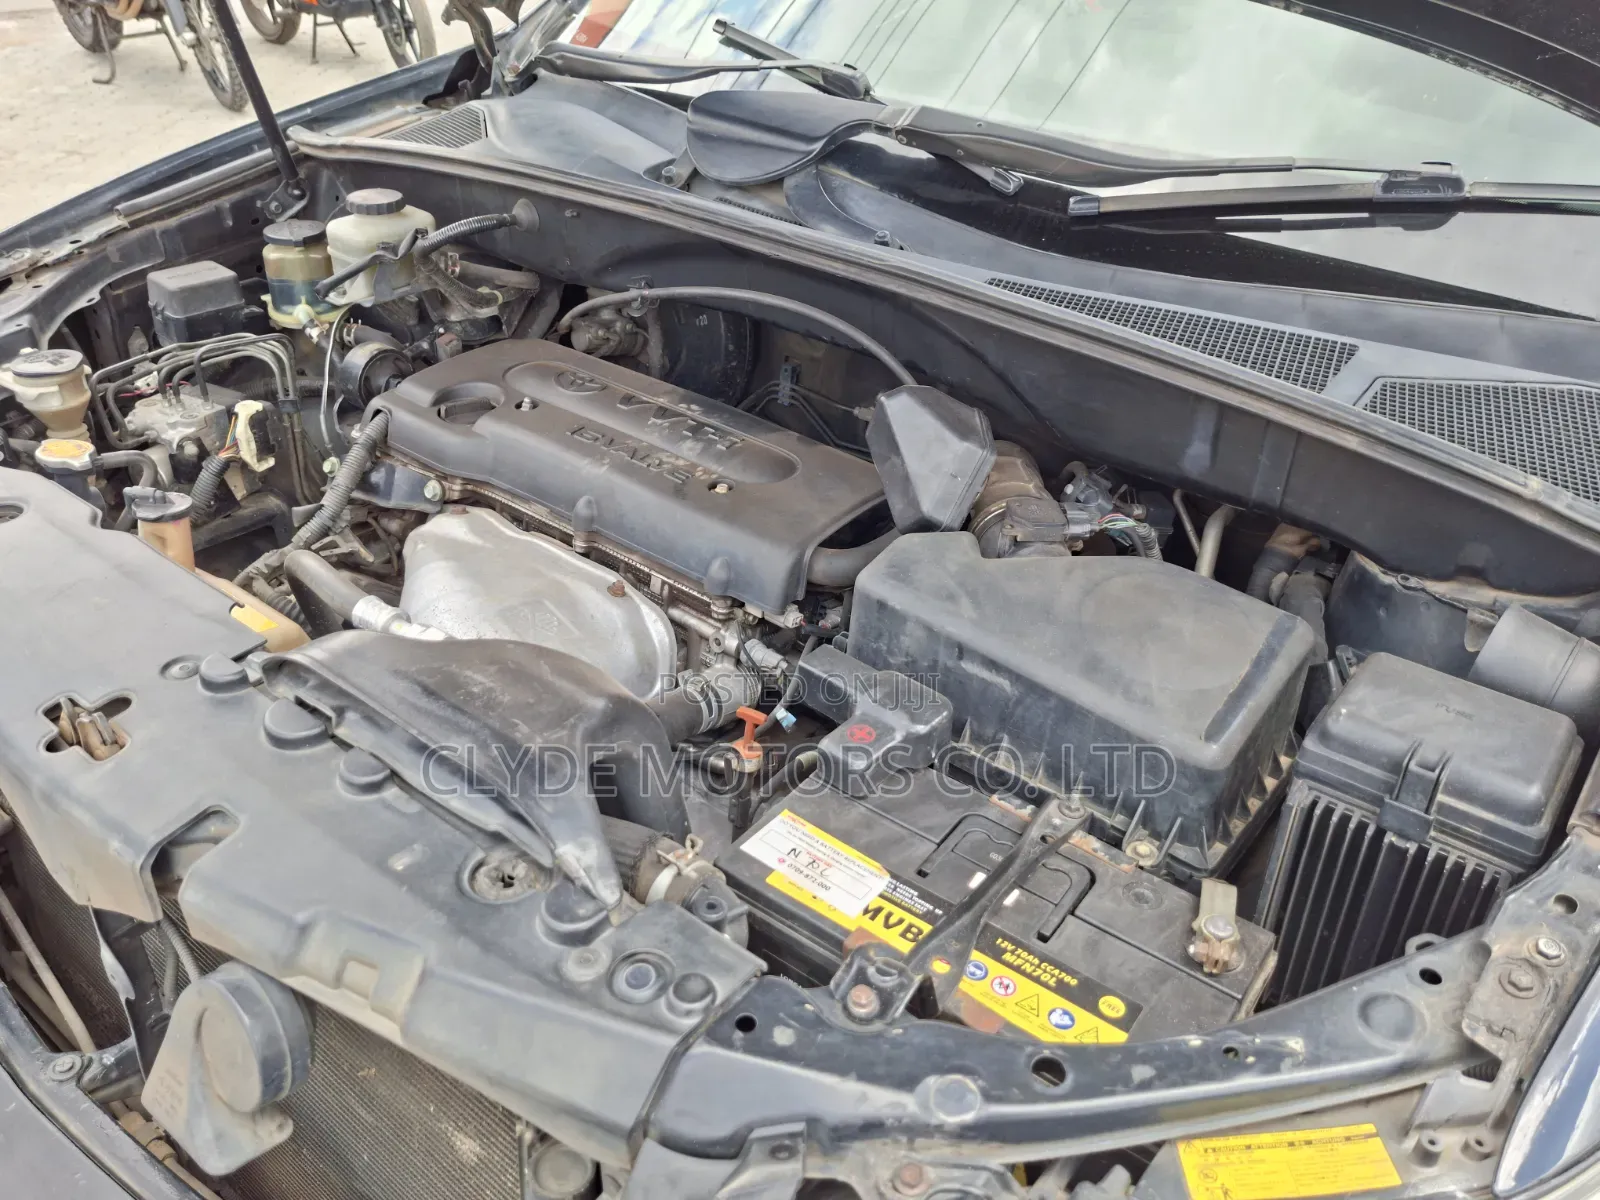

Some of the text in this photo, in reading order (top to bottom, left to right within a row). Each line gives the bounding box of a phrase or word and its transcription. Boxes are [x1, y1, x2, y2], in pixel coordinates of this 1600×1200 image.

[787, 823, 801, 832] YOU
[800, 830, 816, 840] NEED
[819, 841, 844, 856] BATTERY
[787, 847, 801, 859] N
[785, 862, 832, 891] 0709-872-000
[995, 936, 1078, 987] 12V 70Ah CCA700
[1001, 949, 1058, 988] MFN70L
